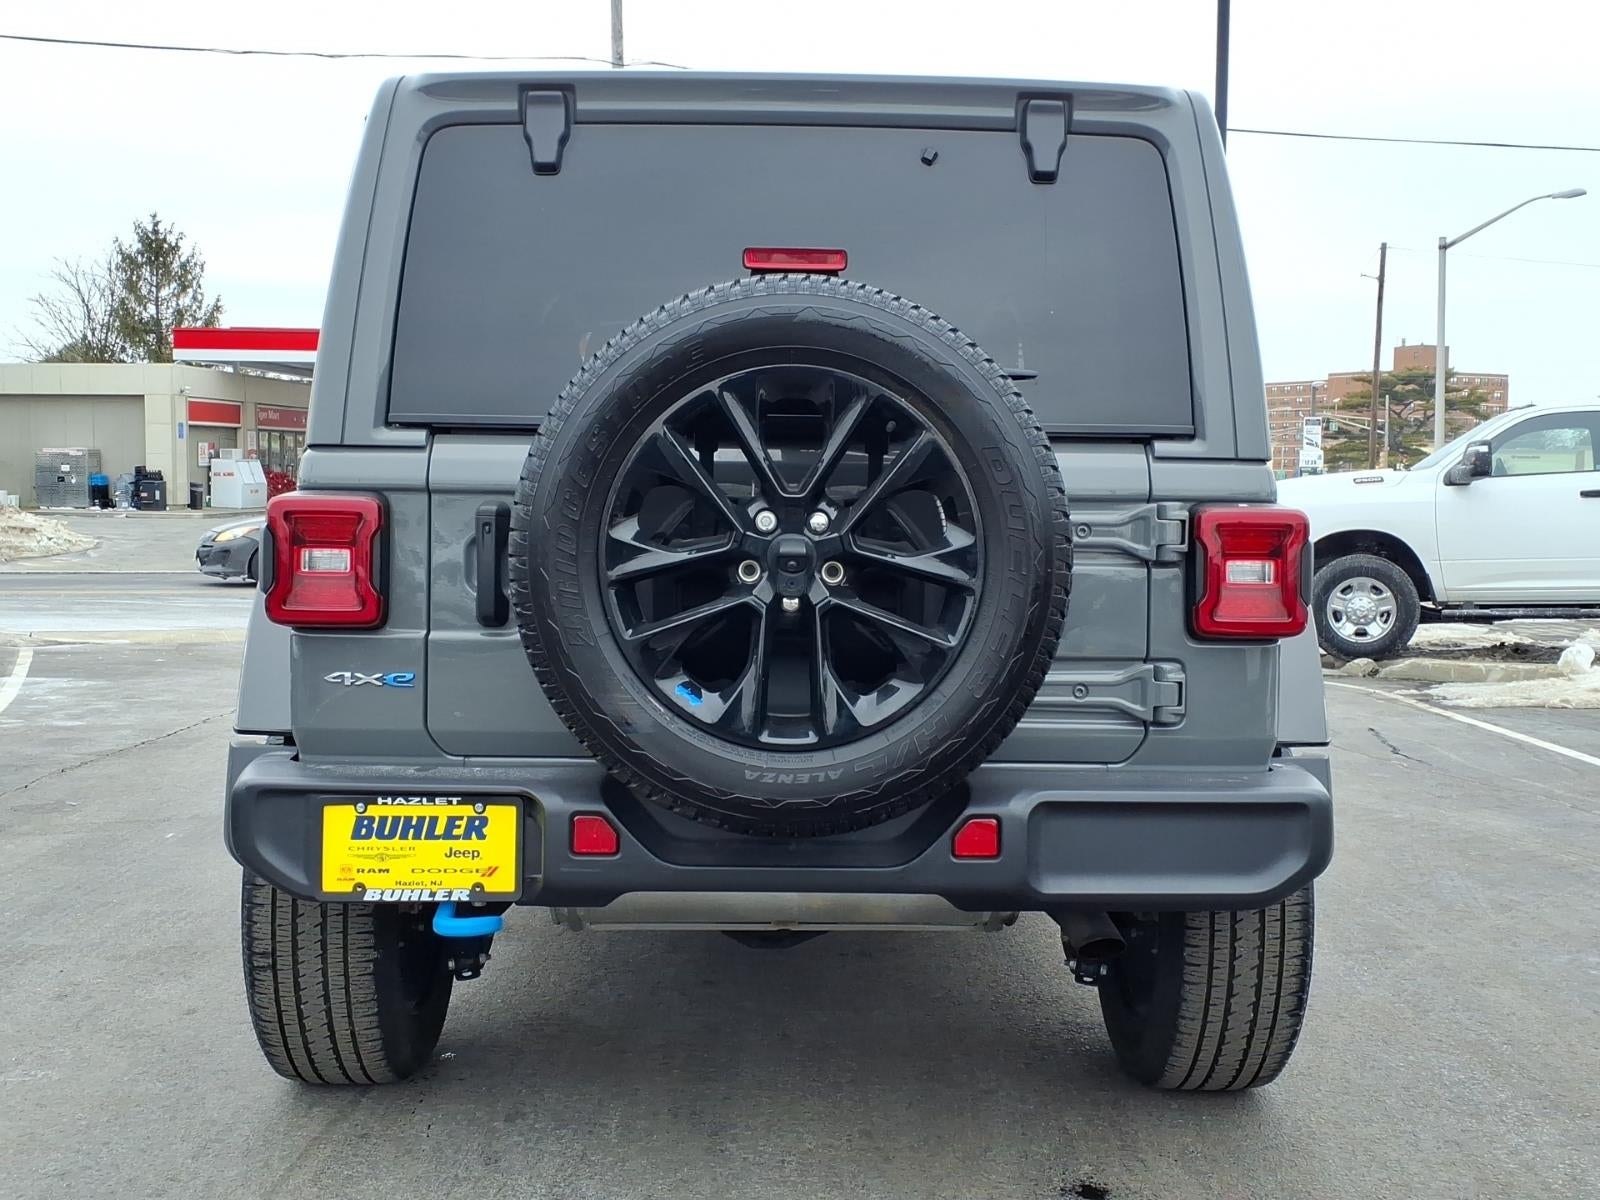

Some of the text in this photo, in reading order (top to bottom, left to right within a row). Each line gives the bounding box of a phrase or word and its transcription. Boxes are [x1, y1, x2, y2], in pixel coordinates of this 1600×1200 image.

[743, 767, 844, 784] ALENZA
[377, 796, 462, 806] HAZLET
[350, 815, 489, 841] BUHLER
[444, 847, 481, 860] Jeep
[395, 879, 428, 887] Hazlet,
[363, 888, 470, 901] BUHLER
